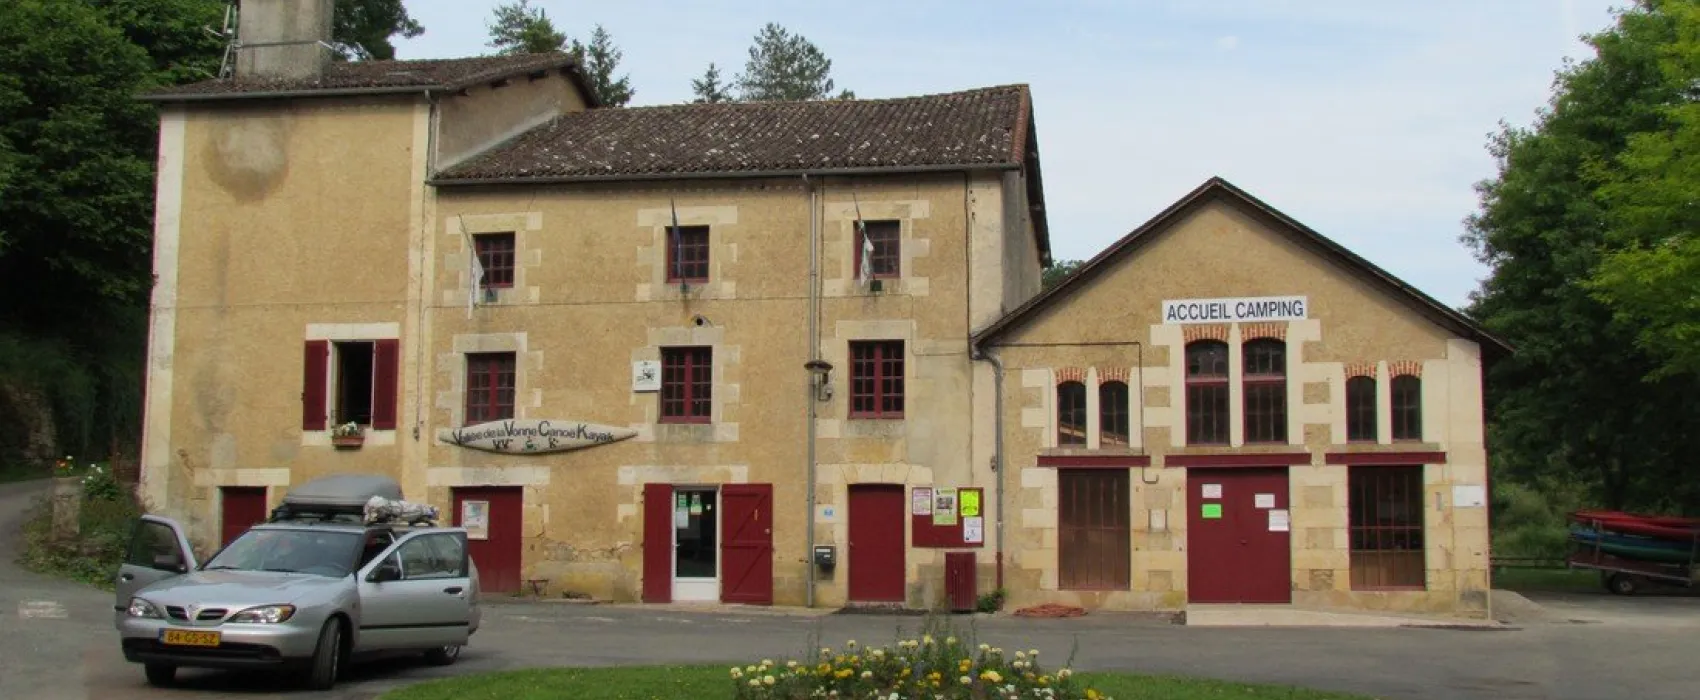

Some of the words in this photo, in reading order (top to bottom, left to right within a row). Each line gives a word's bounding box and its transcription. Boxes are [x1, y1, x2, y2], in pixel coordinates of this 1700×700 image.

[1167, 303, 1231, 320] ACCUEIL
[1235, 300, 1304, 318] CAMPING
[484, 429, 497, 438] de
[504, 420, 537, 437] Vonne
[577, 423, 615, 444] Kayak
